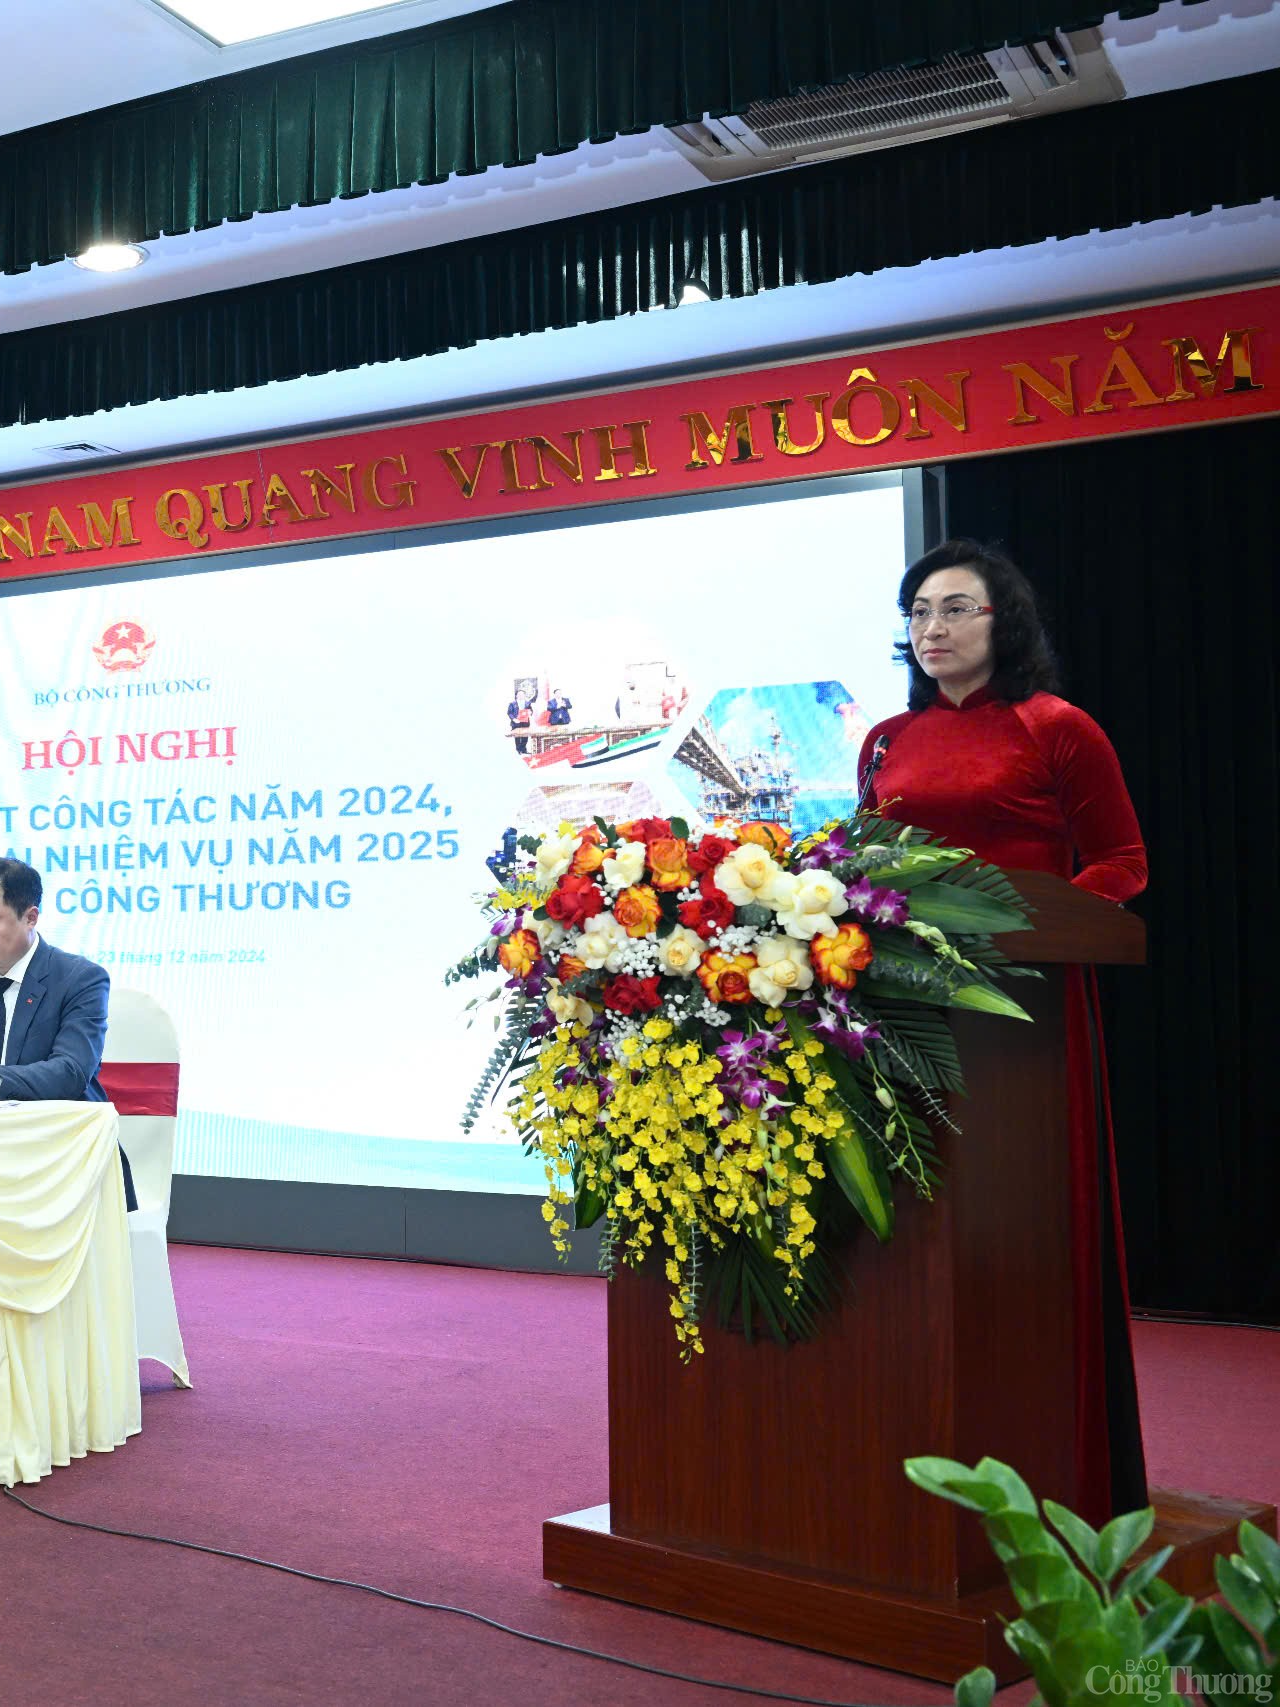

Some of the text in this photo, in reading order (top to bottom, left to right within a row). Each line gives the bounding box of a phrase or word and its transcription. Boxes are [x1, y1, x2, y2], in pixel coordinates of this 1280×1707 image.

[155, 453, 418, 549] QUANG
[434, 419, 658, 500] VINH
[680, 367, 972, 470] MUÔN
[1002, 323, 1266, 426] NĂM
[34, 677, 212, 708] BỘ CÔNG THƯƠNG
[21, 726, 238, 776] HỘI NGHỊ
[29, 794, 132, 831] CÔNG
[144, 788, 217, 825] TÁC
[230, 783, 323, 822] NĂM
[338, 783, 452, 817] 2024,
[45, 834, 168, 878] NHIỆM
[181, 838, 233, 874] VỤ
[247, 828, 341, 866] NĂM
[357, 829, 460, 863] 2025
[55, 878, 161, 914] CÔNG
[171, 880, 352, 912] THƯƠNG
[227, 948, 266, 964] 2024
